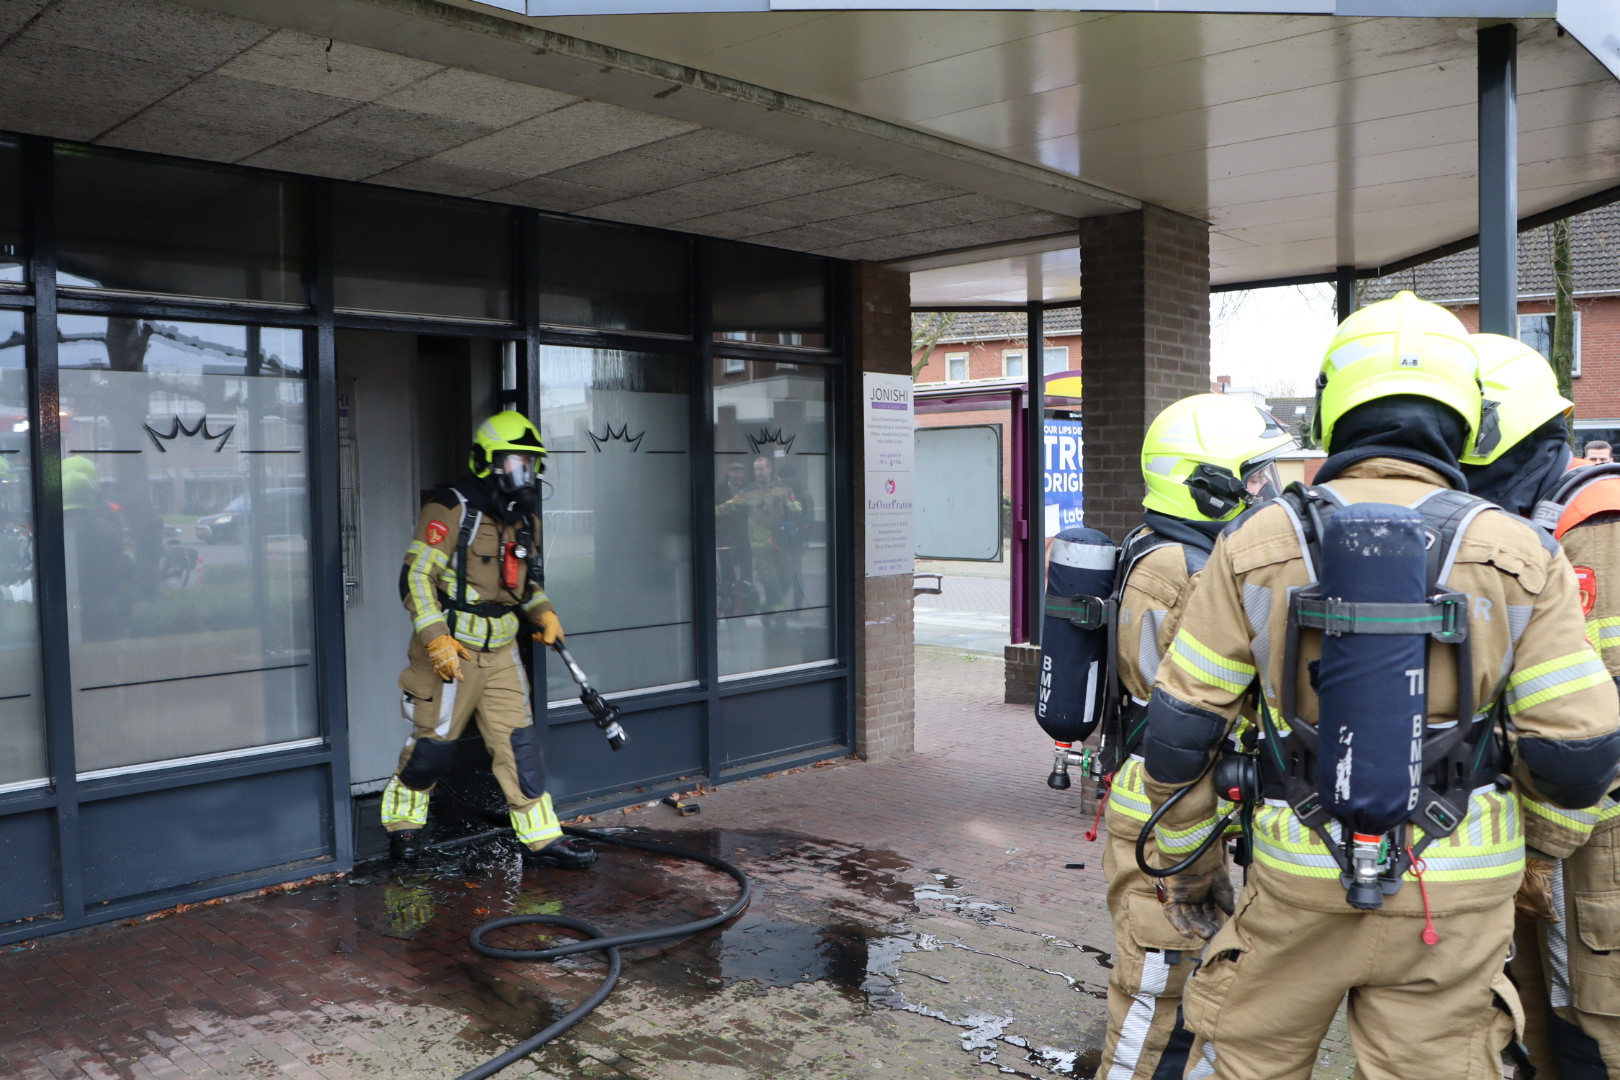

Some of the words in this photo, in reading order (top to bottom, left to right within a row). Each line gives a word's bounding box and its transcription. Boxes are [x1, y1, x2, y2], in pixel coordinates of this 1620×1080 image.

[870, 388, 908, 402] JONISHI
[1059, 426, 1072, 435] LIPS
[1407, 714, 1422, 811] BMWB
